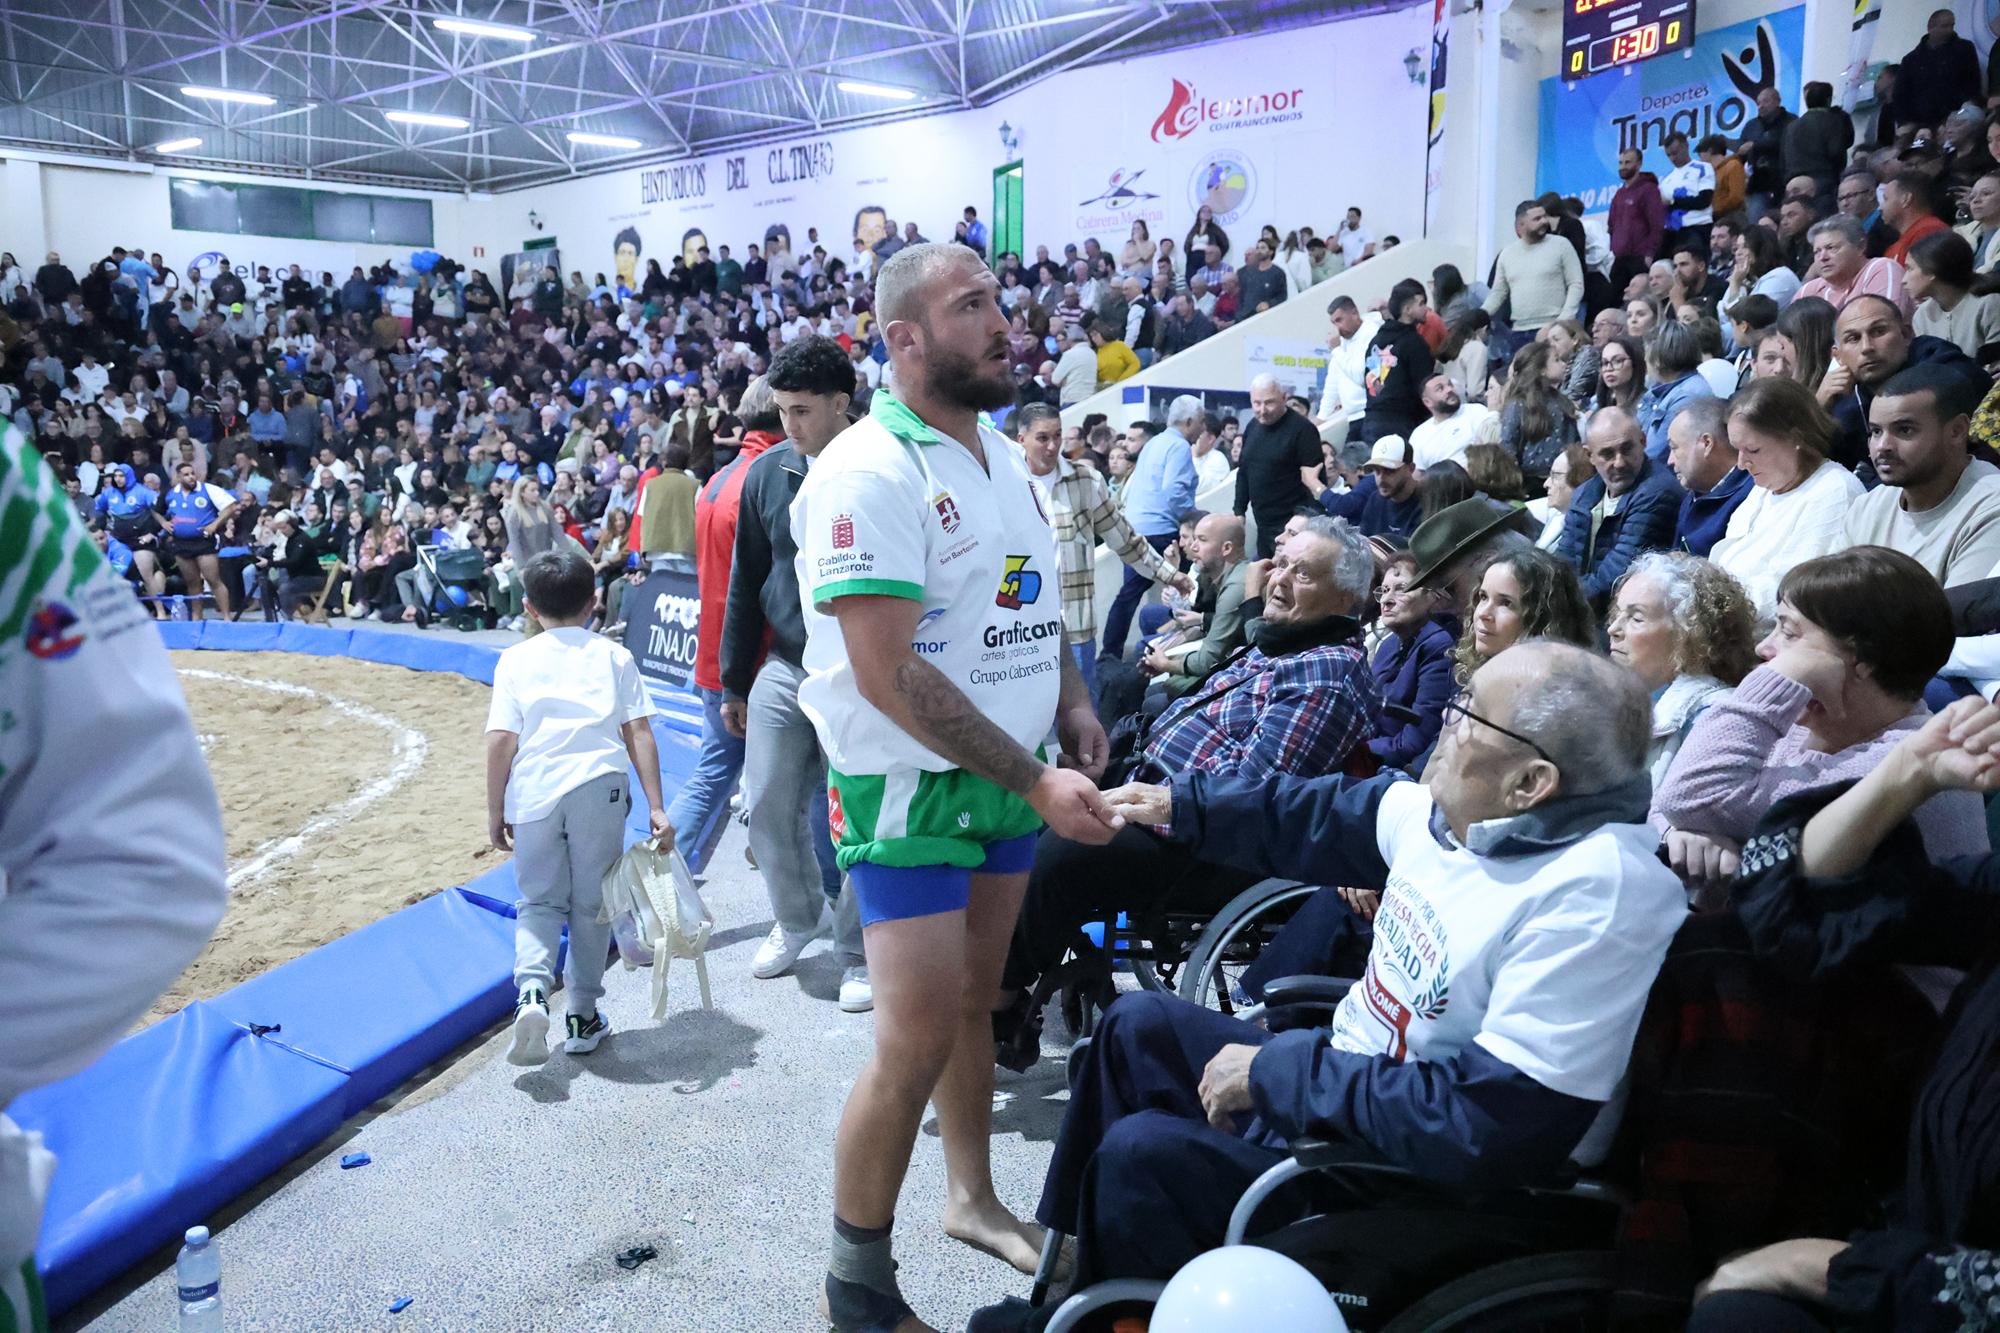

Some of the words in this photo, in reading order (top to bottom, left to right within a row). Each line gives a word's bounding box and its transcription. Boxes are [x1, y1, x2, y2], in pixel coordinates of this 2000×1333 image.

[1612, 26, 1657, 62] 1:30
[1666, 20, 1681, 45] 0
[1571, 50, 1584, 72] 0
[1641, 85, 1709, 112] Deportes
[1209, 111, 1304, 133] CONTRAINCENDIOS
[641, 163, 707, 205] HISTORICOS
[726, 157, 749, 191] DEL
[818, 552, 857, 567] Cabildo
[860, 552, 875, 562] de
[819, 563, 873, 578] Lanzarote
[940, 556, 952, 565] San
[648, 624, 699, 665] TINAJO
[981, 651, 1006, 662] artes
[970, 669, 1007, 686] Grupo
[1009, 660, 1053, 680] Cabrera
